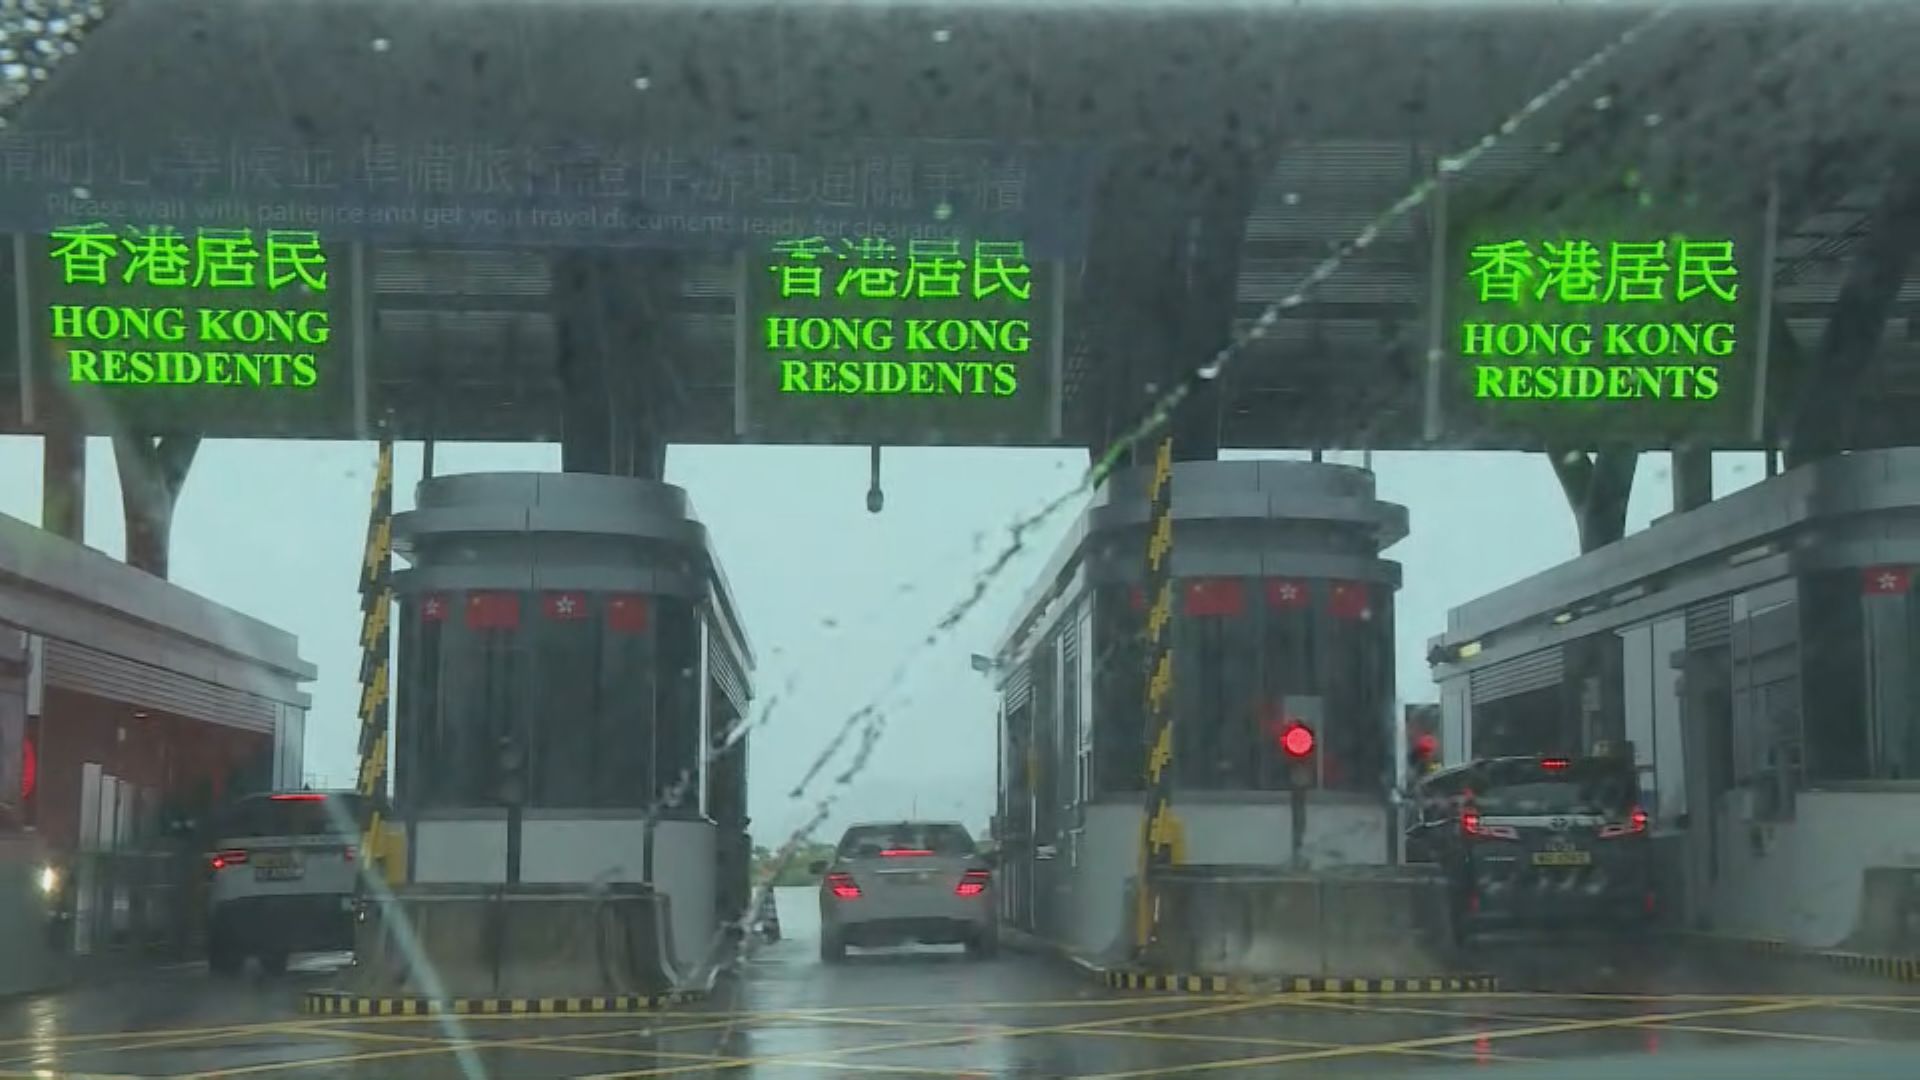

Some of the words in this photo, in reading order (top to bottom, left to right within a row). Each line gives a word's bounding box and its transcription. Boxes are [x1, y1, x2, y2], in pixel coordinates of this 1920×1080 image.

[50, 223, 328, 291] 香港居民
[768, 236, 1031, 300] 香港居民
[1468, 239, 1738, 303] 香港居民
[50, 305, 184, 341] HONG
[200, 308, 329, 343] KONG
[767, 317, 893, 351] HONG
[905, 319, 1030, 353] KONG
[1464, 323, 1593, 355] HONG
[1605, 323, 1736, 356] KONG
[69, 350, 318, 386] RESIDENTS
[780, 361, 1017, 395] RESIDENTS
[1476, 366, 1719, 399] RESIDENTS
